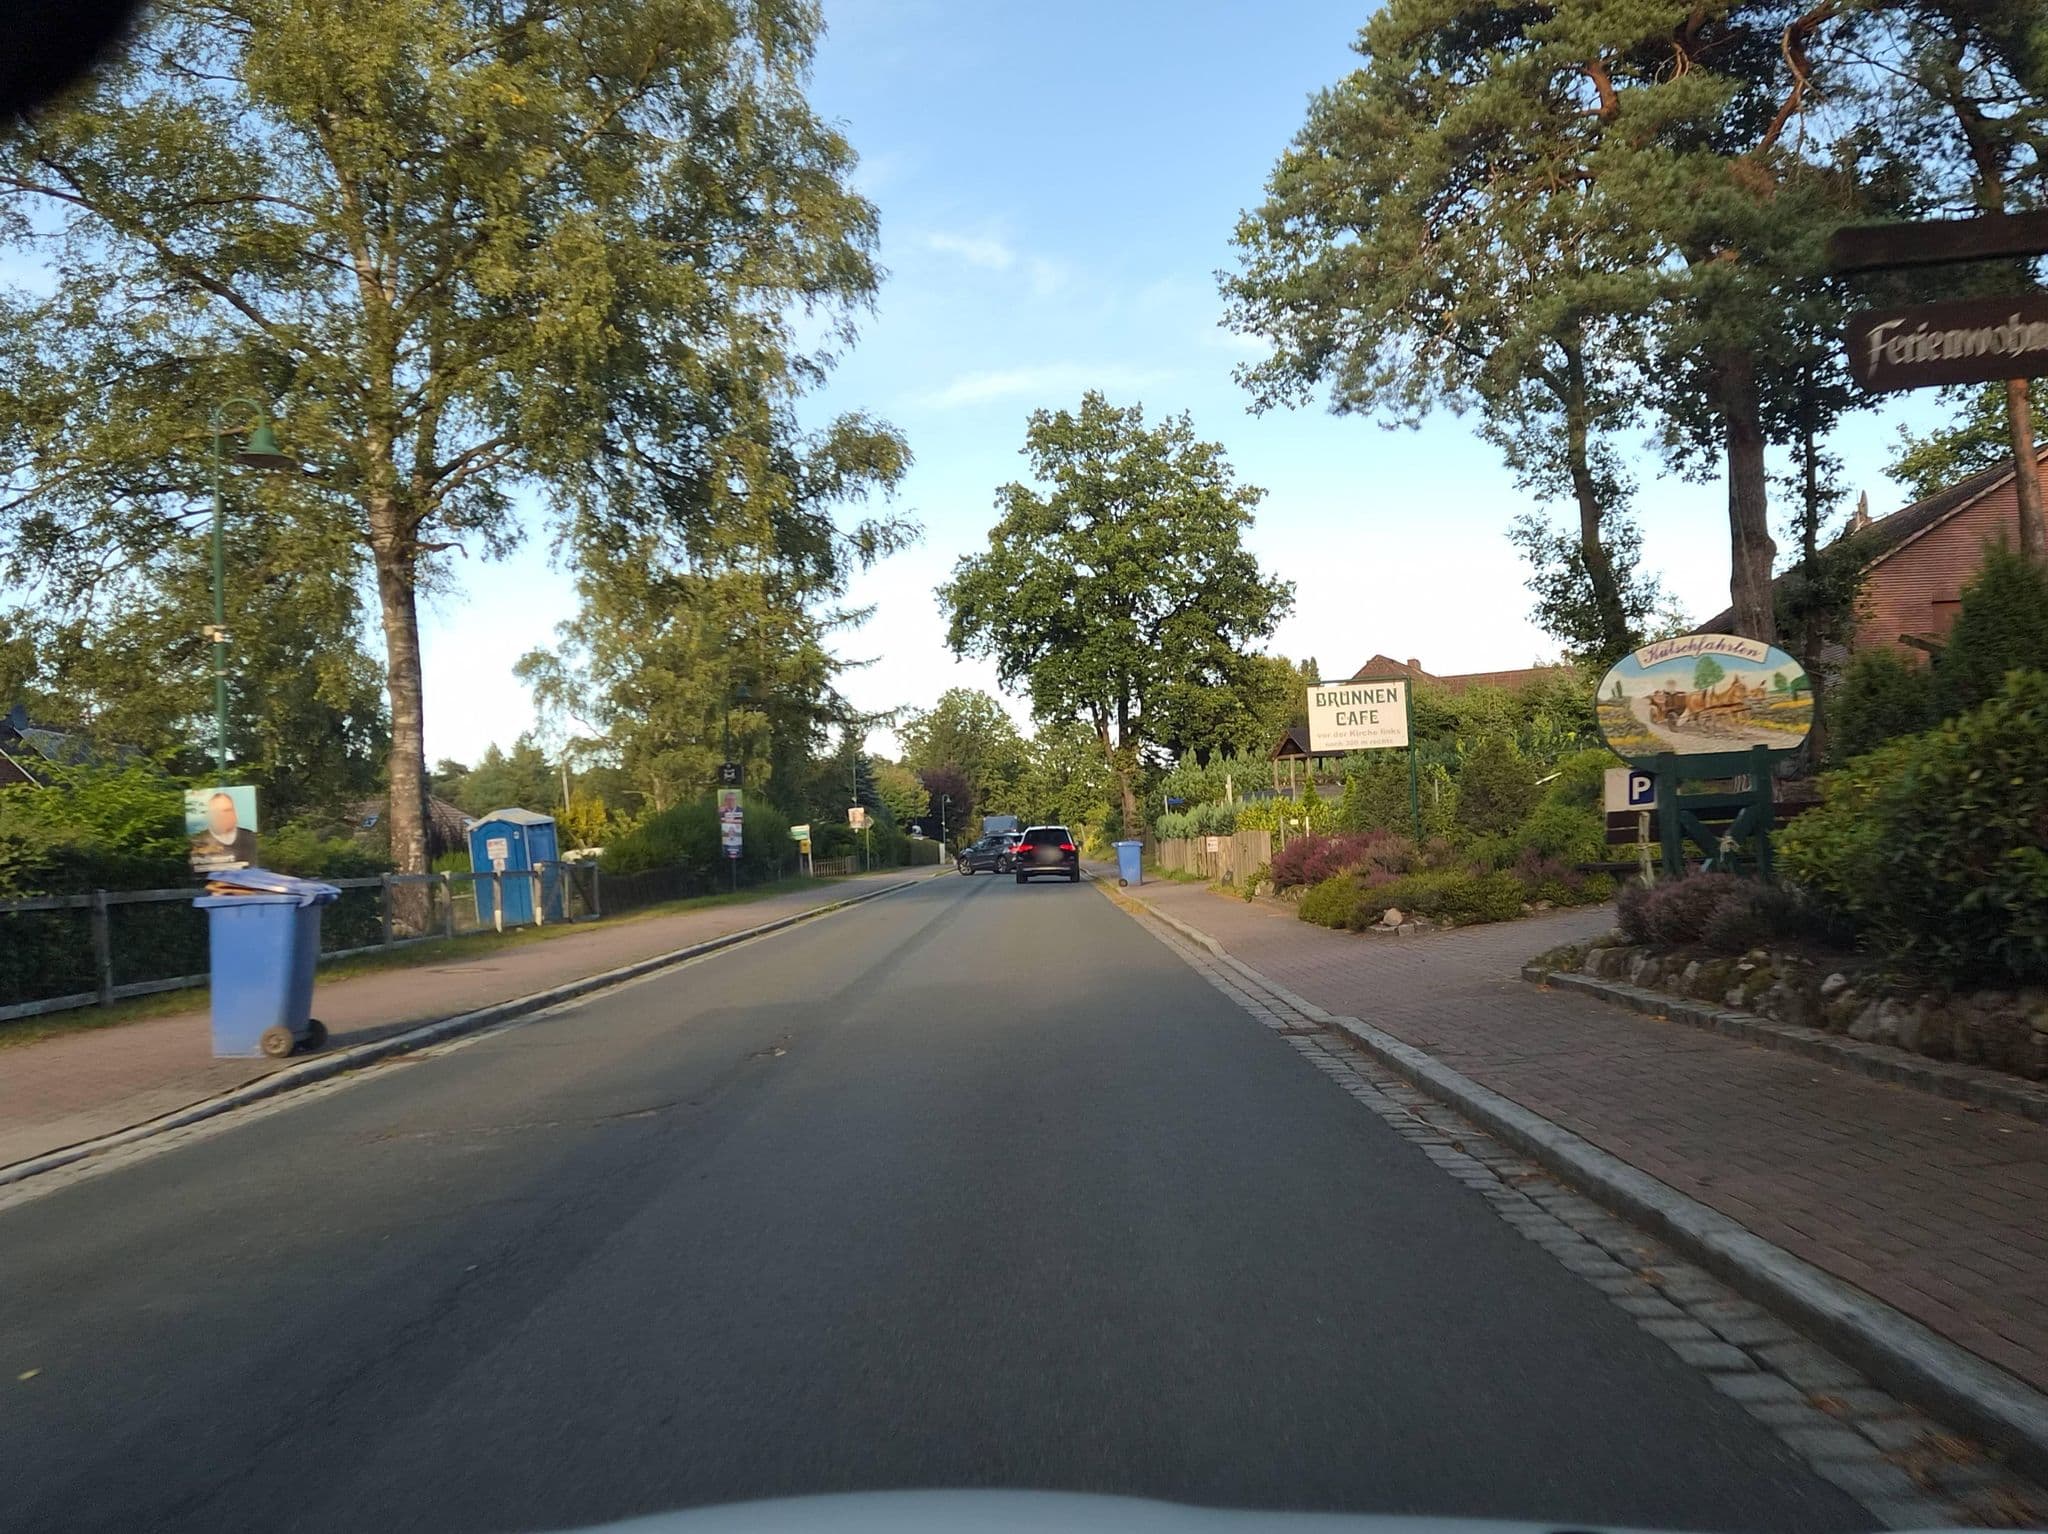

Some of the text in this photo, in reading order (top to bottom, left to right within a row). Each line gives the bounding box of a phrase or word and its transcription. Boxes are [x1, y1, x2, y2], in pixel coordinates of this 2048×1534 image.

[1644, 635, 1761, 663] Kutschfahrten
[1315, 688, 1398, 707] BRUNNEN
[1336, 710, 1380, 726] CAFE
[1632, 776, 1651, 800] P
